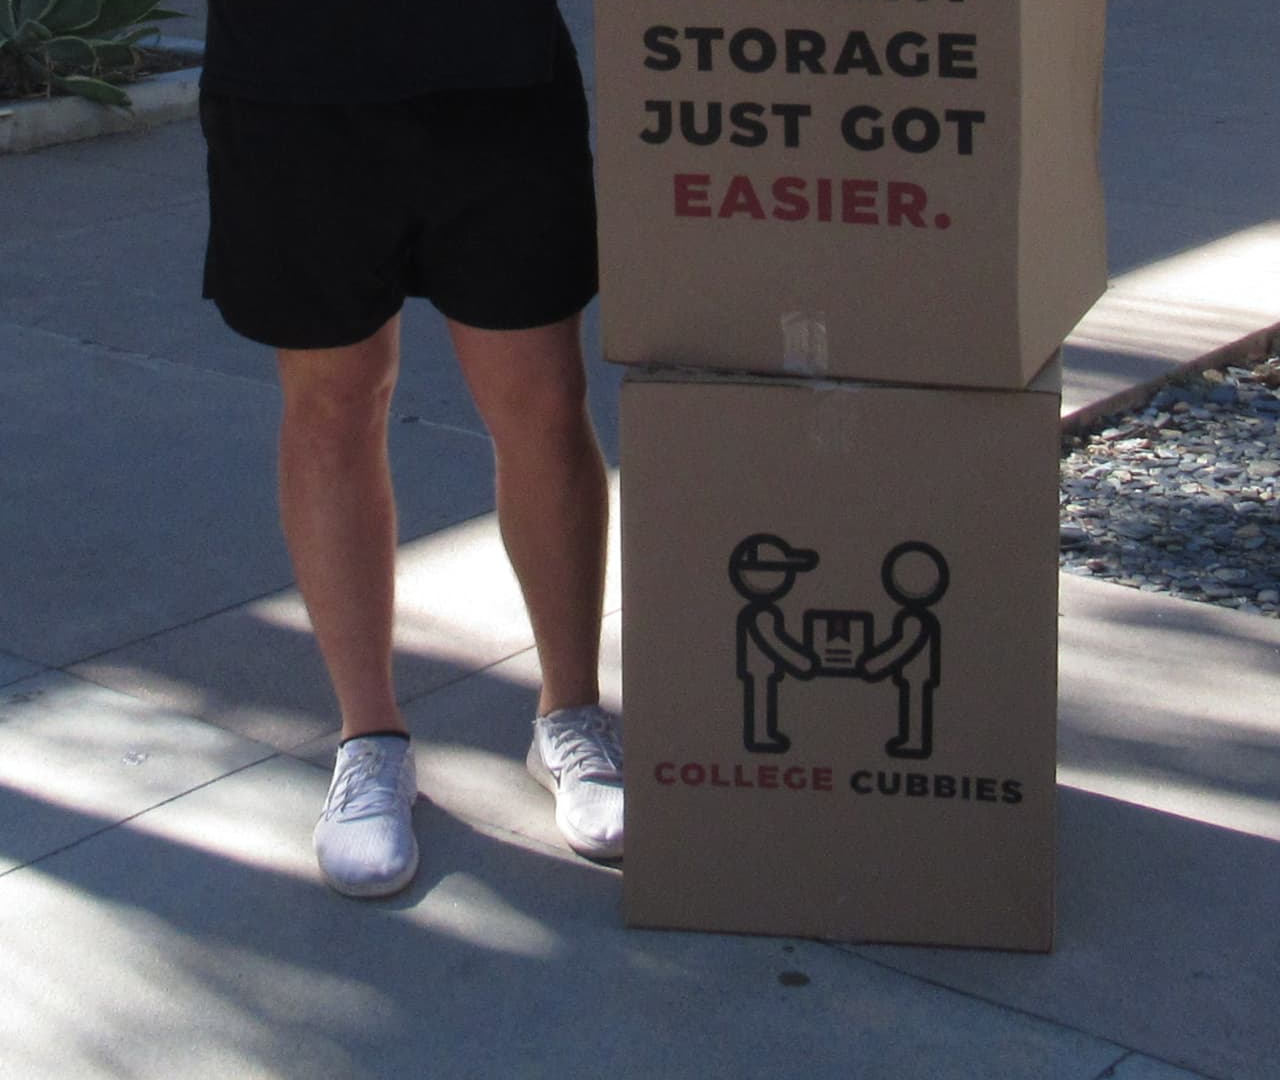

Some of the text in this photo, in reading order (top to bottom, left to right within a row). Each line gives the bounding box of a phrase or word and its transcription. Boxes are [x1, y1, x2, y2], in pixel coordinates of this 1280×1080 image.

[642, 25, 978, 80] STORAGE
[638, 99, 986, 155] JUST GOT
[673, 172, 952, 231] EASIER.
[653, 761, 1024, 805] COLLEGE CUBBIES
